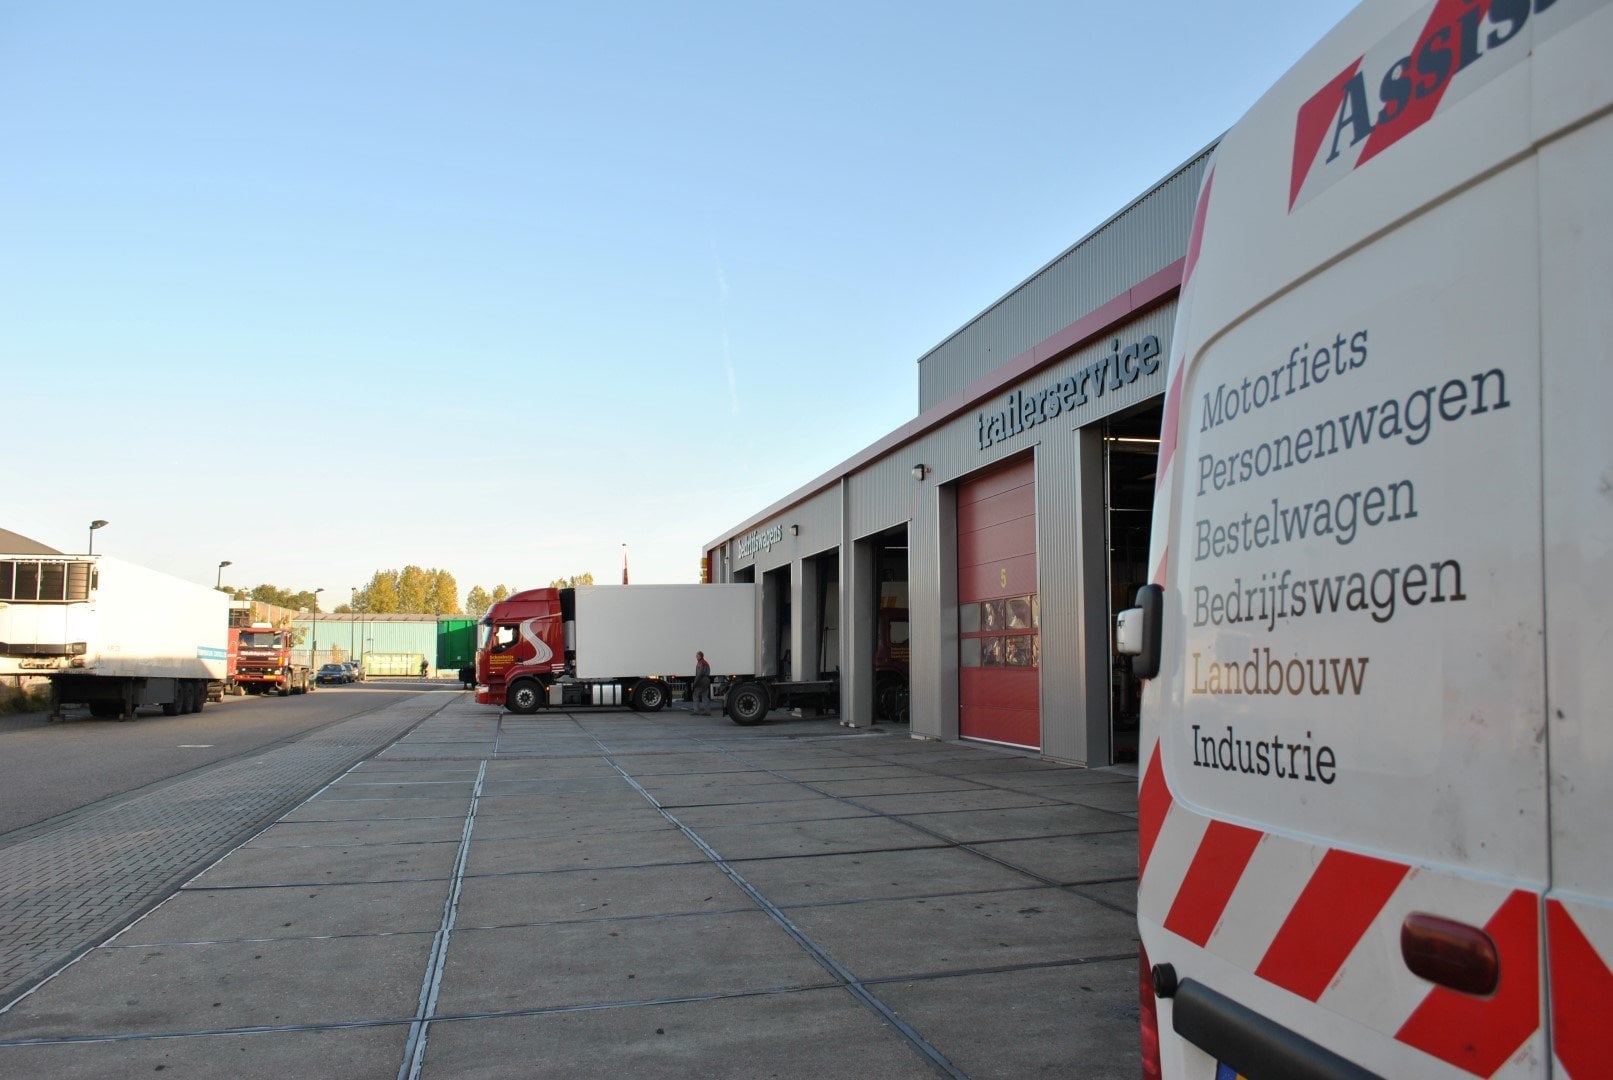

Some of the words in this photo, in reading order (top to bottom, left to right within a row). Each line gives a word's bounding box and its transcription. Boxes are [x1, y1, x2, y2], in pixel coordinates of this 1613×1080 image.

[1325, 0, 1559, 165] Assis
[978, 334, 1161, 451] trailerservice
[1200, 329, 1368, 433] Motorfiets
[1196, 367, 1510, 497] Personenwagen
[1195, 477, 1418, 562] Bestelwagen
[1193, 558, 1467, 632] Bedrijfswagen
[1191, 648, 1370, 696] Landbouw
[1191, 724, 1337, 784] Industrie
